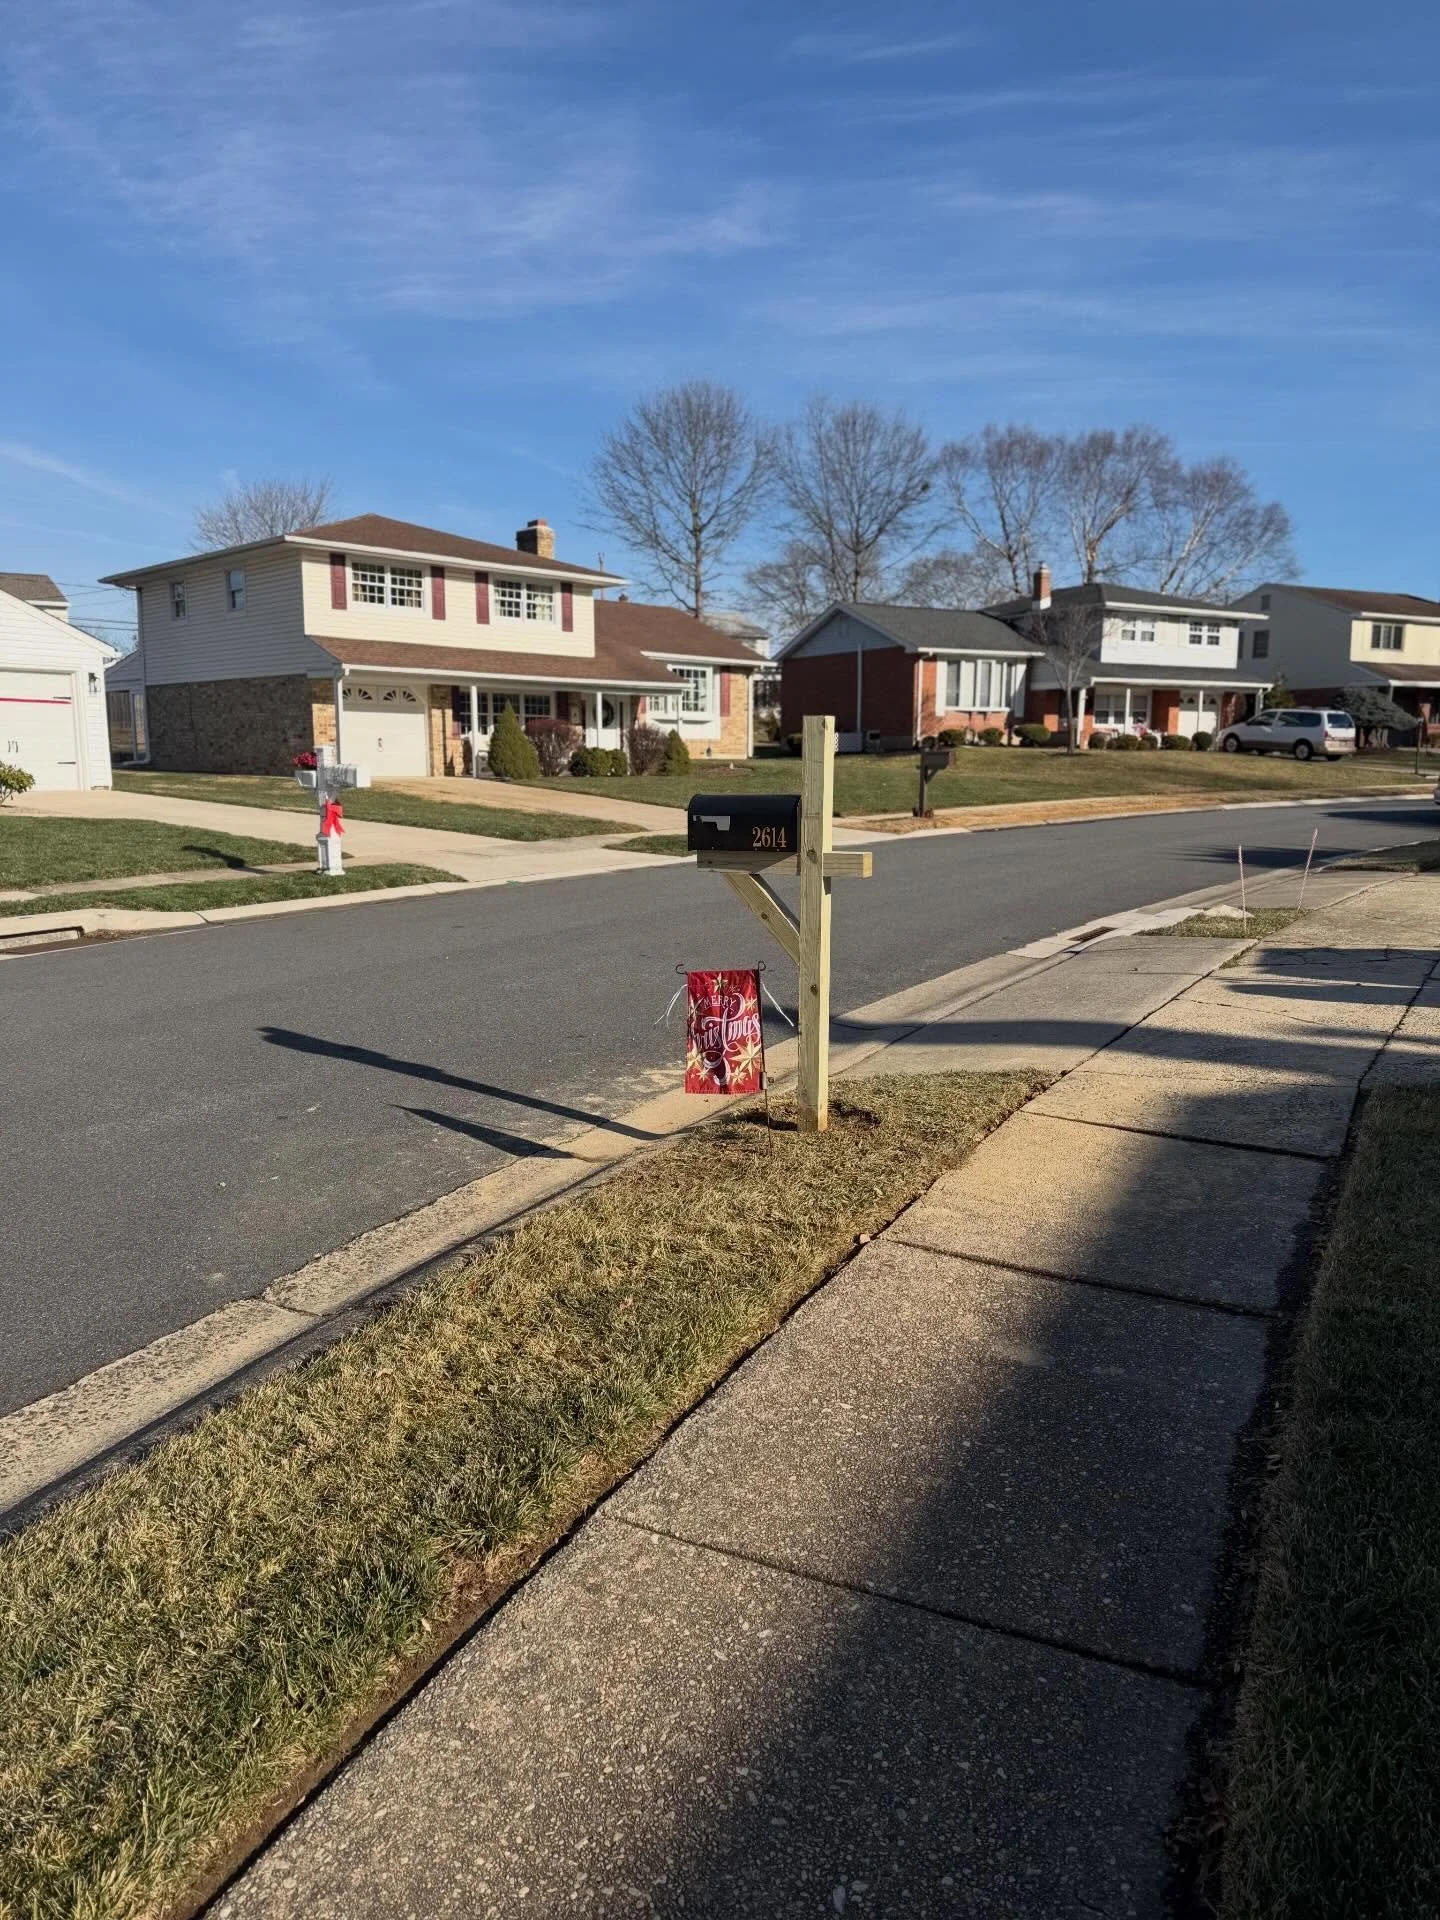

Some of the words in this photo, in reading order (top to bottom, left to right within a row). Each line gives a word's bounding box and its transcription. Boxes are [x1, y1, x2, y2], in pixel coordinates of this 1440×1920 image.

[752, 826, 787, 848] 2614
[703, 994, 737, 1010] MERRY
[690, 993, 761, 1052] hristmas
